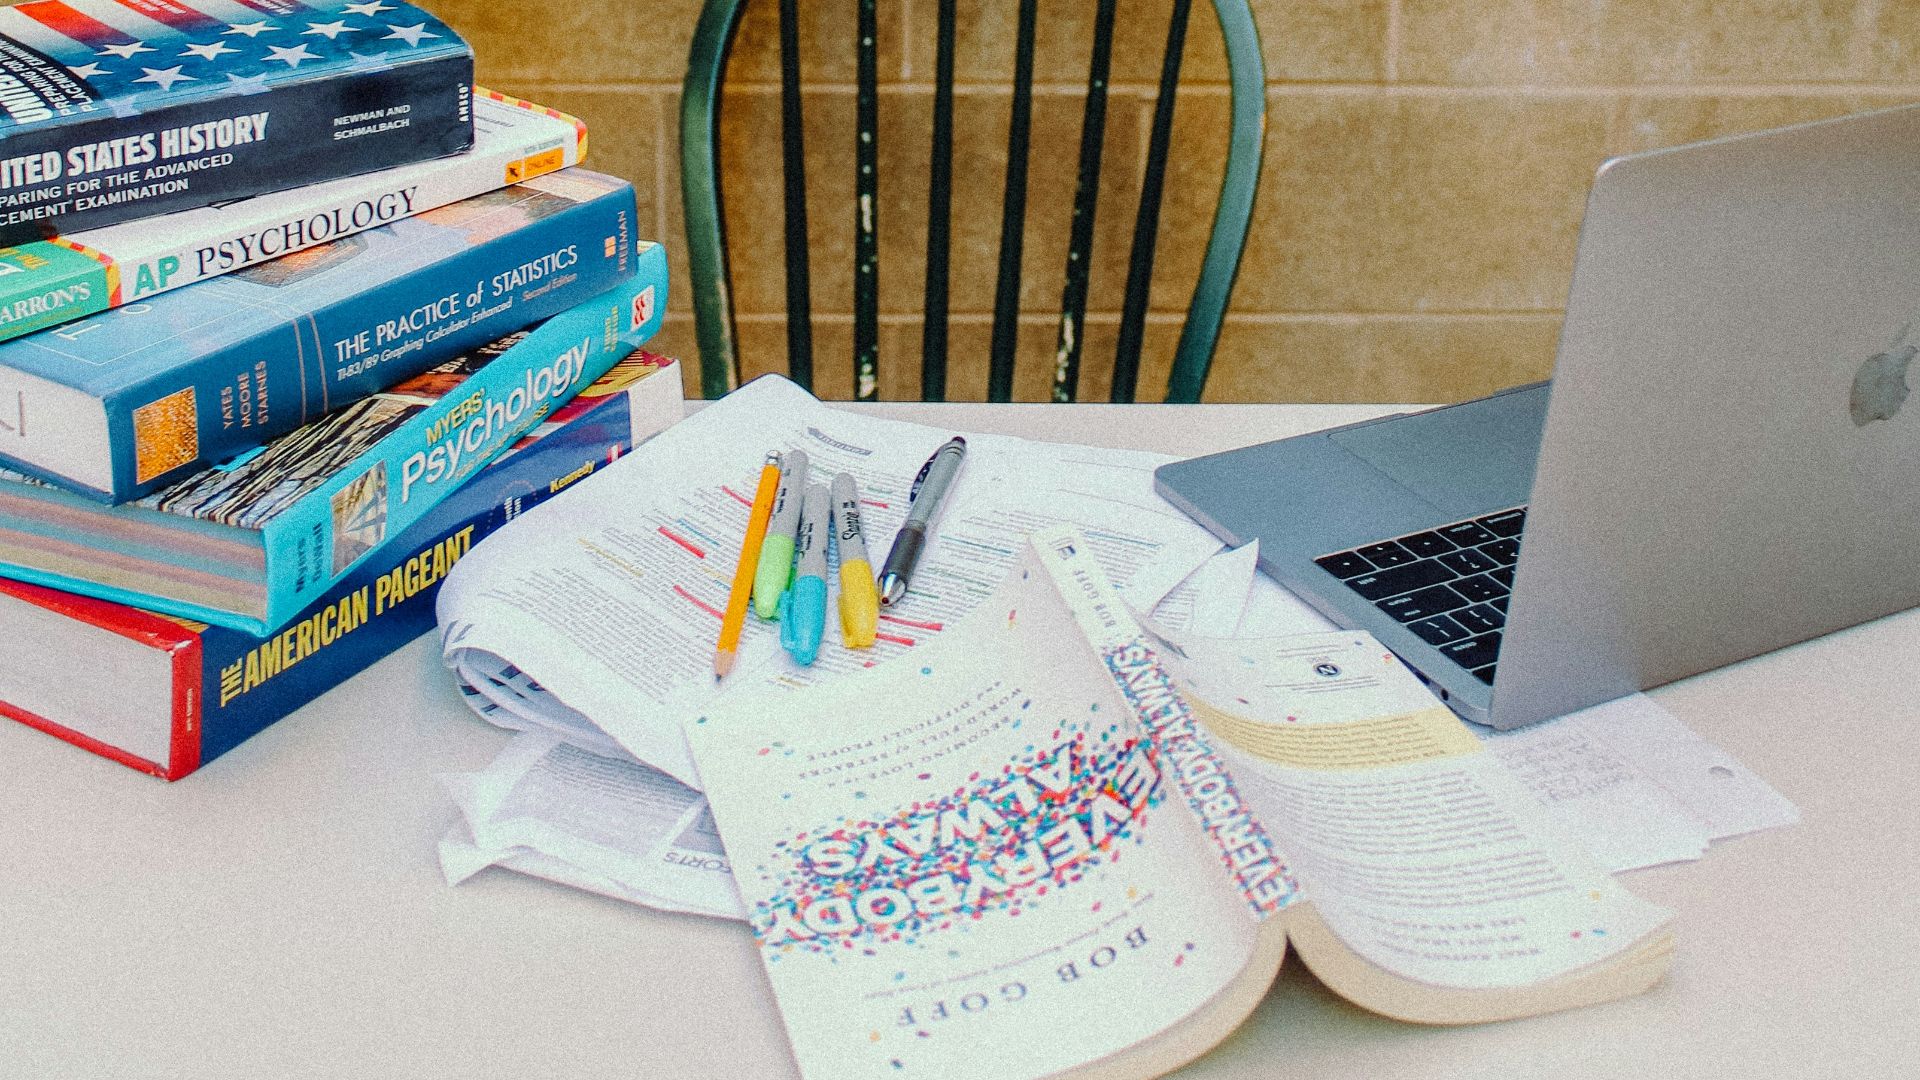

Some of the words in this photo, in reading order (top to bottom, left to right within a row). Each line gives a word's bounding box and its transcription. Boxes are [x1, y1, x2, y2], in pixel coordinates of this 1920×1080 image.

[333, 108, 384, 126] NEWMAN
[386, 104, 411, 117] AND
[333, 118, 410, 140] SCHMALBACH
[0, 150, 62, 189] ITED
[66, 133, 157, 179] STATES
[160, 111, 270, 159] HISTORY
[66, 178, 102, 195] FOR
[105, 170, 141, 188] THE
[145, 152, 234, 179] ADVANCED
[75, 178, 190, 212] EXAMINATION
[133, 255, 180, 297] AP
[195, 185, 418, 277] PSYCHOLOGY
[334, 330, 370, 363] THE
[375, 292, 461, 346] PRACTICE
[465, 281, 484, 308] of
[492, 244, 578, 297] STATISTICS
[380, 335, 425, 362] Graphing
[425, 318, 471, 343] Calculator
[470, 296, 514, 325] Enhanced
[220, 385, 235, 431] YATES
[236, 372, 252, 429] MOORE
[254, 360, 269, 425] STARNES
[425, 388, 486, 448] MYERS'
[401, 336, 591, 504] Psychology
[550, 460, 596, 494] Kennedy
[220, 657, 242, 708] THE
[243, 585, 369, 694] AMERICAN
[375, 524, 475, 617] PAGEANT
[966, 688, 1022, 724] WORLD
[806, 740, 874, 762] PEOPLE
[920, 715, 1010, 763] BECOMING
[798, 751, 889, 780] SETBACKS
[869, 761, 915, 780] LOVE
[805, 742, 1073, 876] ALWAYS
[758, 750, 1159, 944] EVERYBODY
[1056, 926, 1150, 983] BOB
[897, 981, 1028, 1027] GOFF
